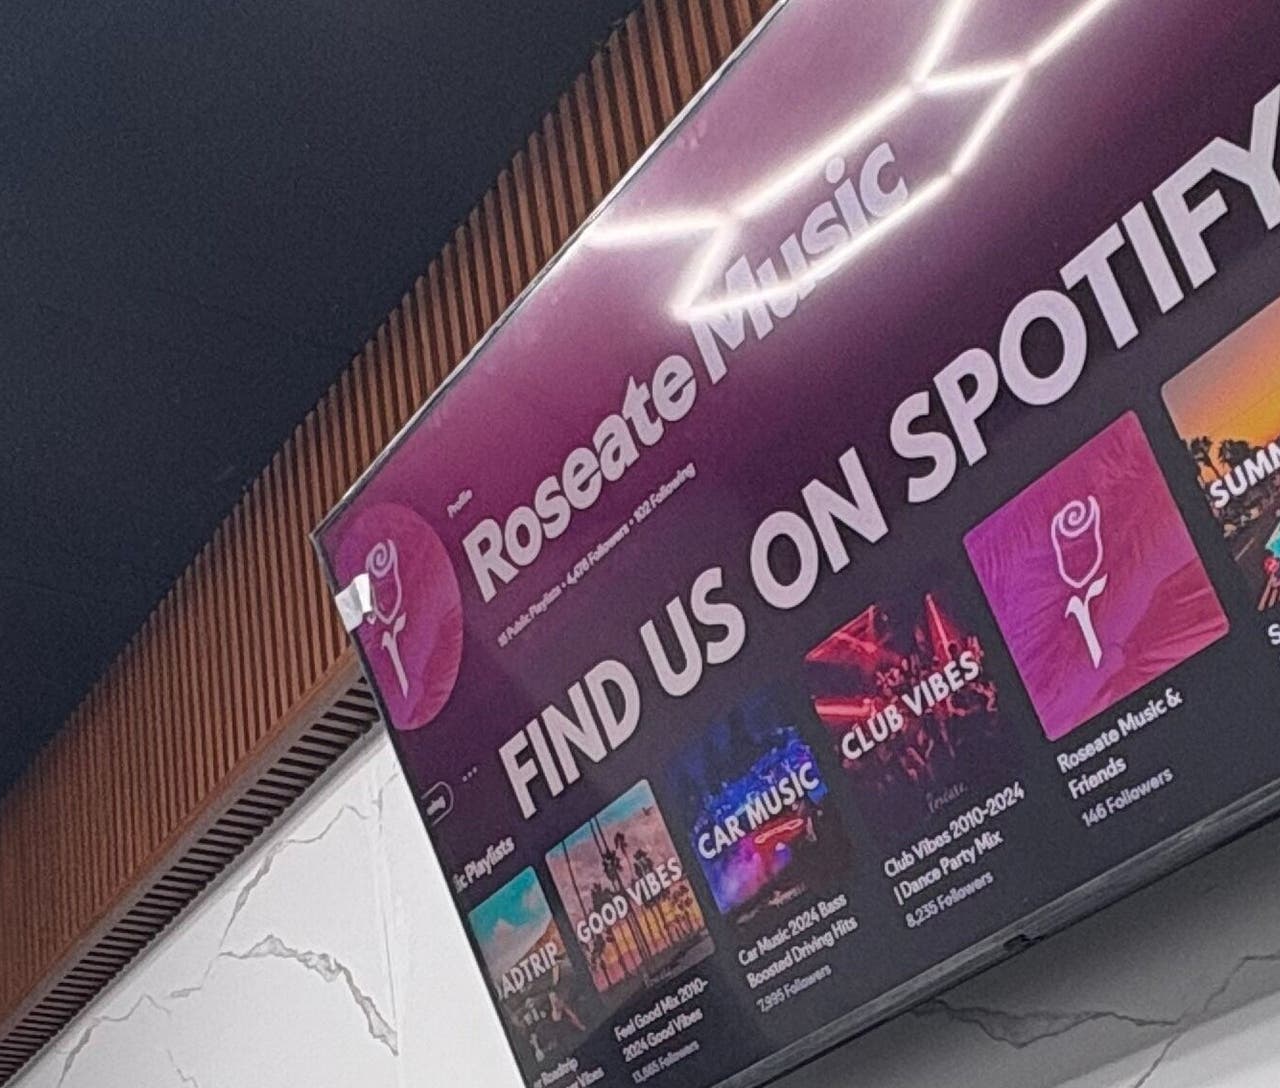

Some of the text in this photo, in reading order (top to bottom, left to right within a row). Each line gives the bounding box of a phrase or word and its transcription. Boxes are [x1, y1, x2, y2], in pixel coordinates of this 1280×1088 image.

[462, 142, 909, 603] Roseate Music
[588, 523, 631, 566] Followers
[648, 462, 697, 509] Following
[498, 660, 641, 820] FIND
[640, 567, 746, 697] US
[750, 447, 889, 610] ON
[840, 653, 980, 761] CLUB VIBES
[1056, 687, 1183, 774] Roseate Music &
[698, 762, 820, 863] CAR MUSIC
[1068, 757, 1127, 800] Friends
[1082, 768, 1174, 828] 146 Followers
[464, 836, 515, 885] Playlists
[884, 781, 1025, 878] Club Vibes 2010-2024
[900, 866, 942, 900] Dance
[939, 846, 976, 876] Party
[974, 831, 1004, 855] Mix
[576, 857, 684, 944] GOOD VIBES
[738, 945, 758, 966] Car
[756, 927, 791, 955] Music
[787, 909, 819, 937] 2024
[817, 894, 848, 919] Bass
[905, 871, 994, 929] 8,235 Followers
[746, 916, 858, 989] Boosted Driving Hits
[783, 964, 832, 998] Followers
[613, 1018, 635, 1042] Feel
[634, 1003, 662, 1029] Good
[660, 995, 681, 1014] Mix
[646, 1021, 676, 1047] Good
[673, 1008, 704, 1032] Vibes
[658, 1040, 700, 1069] Followers
